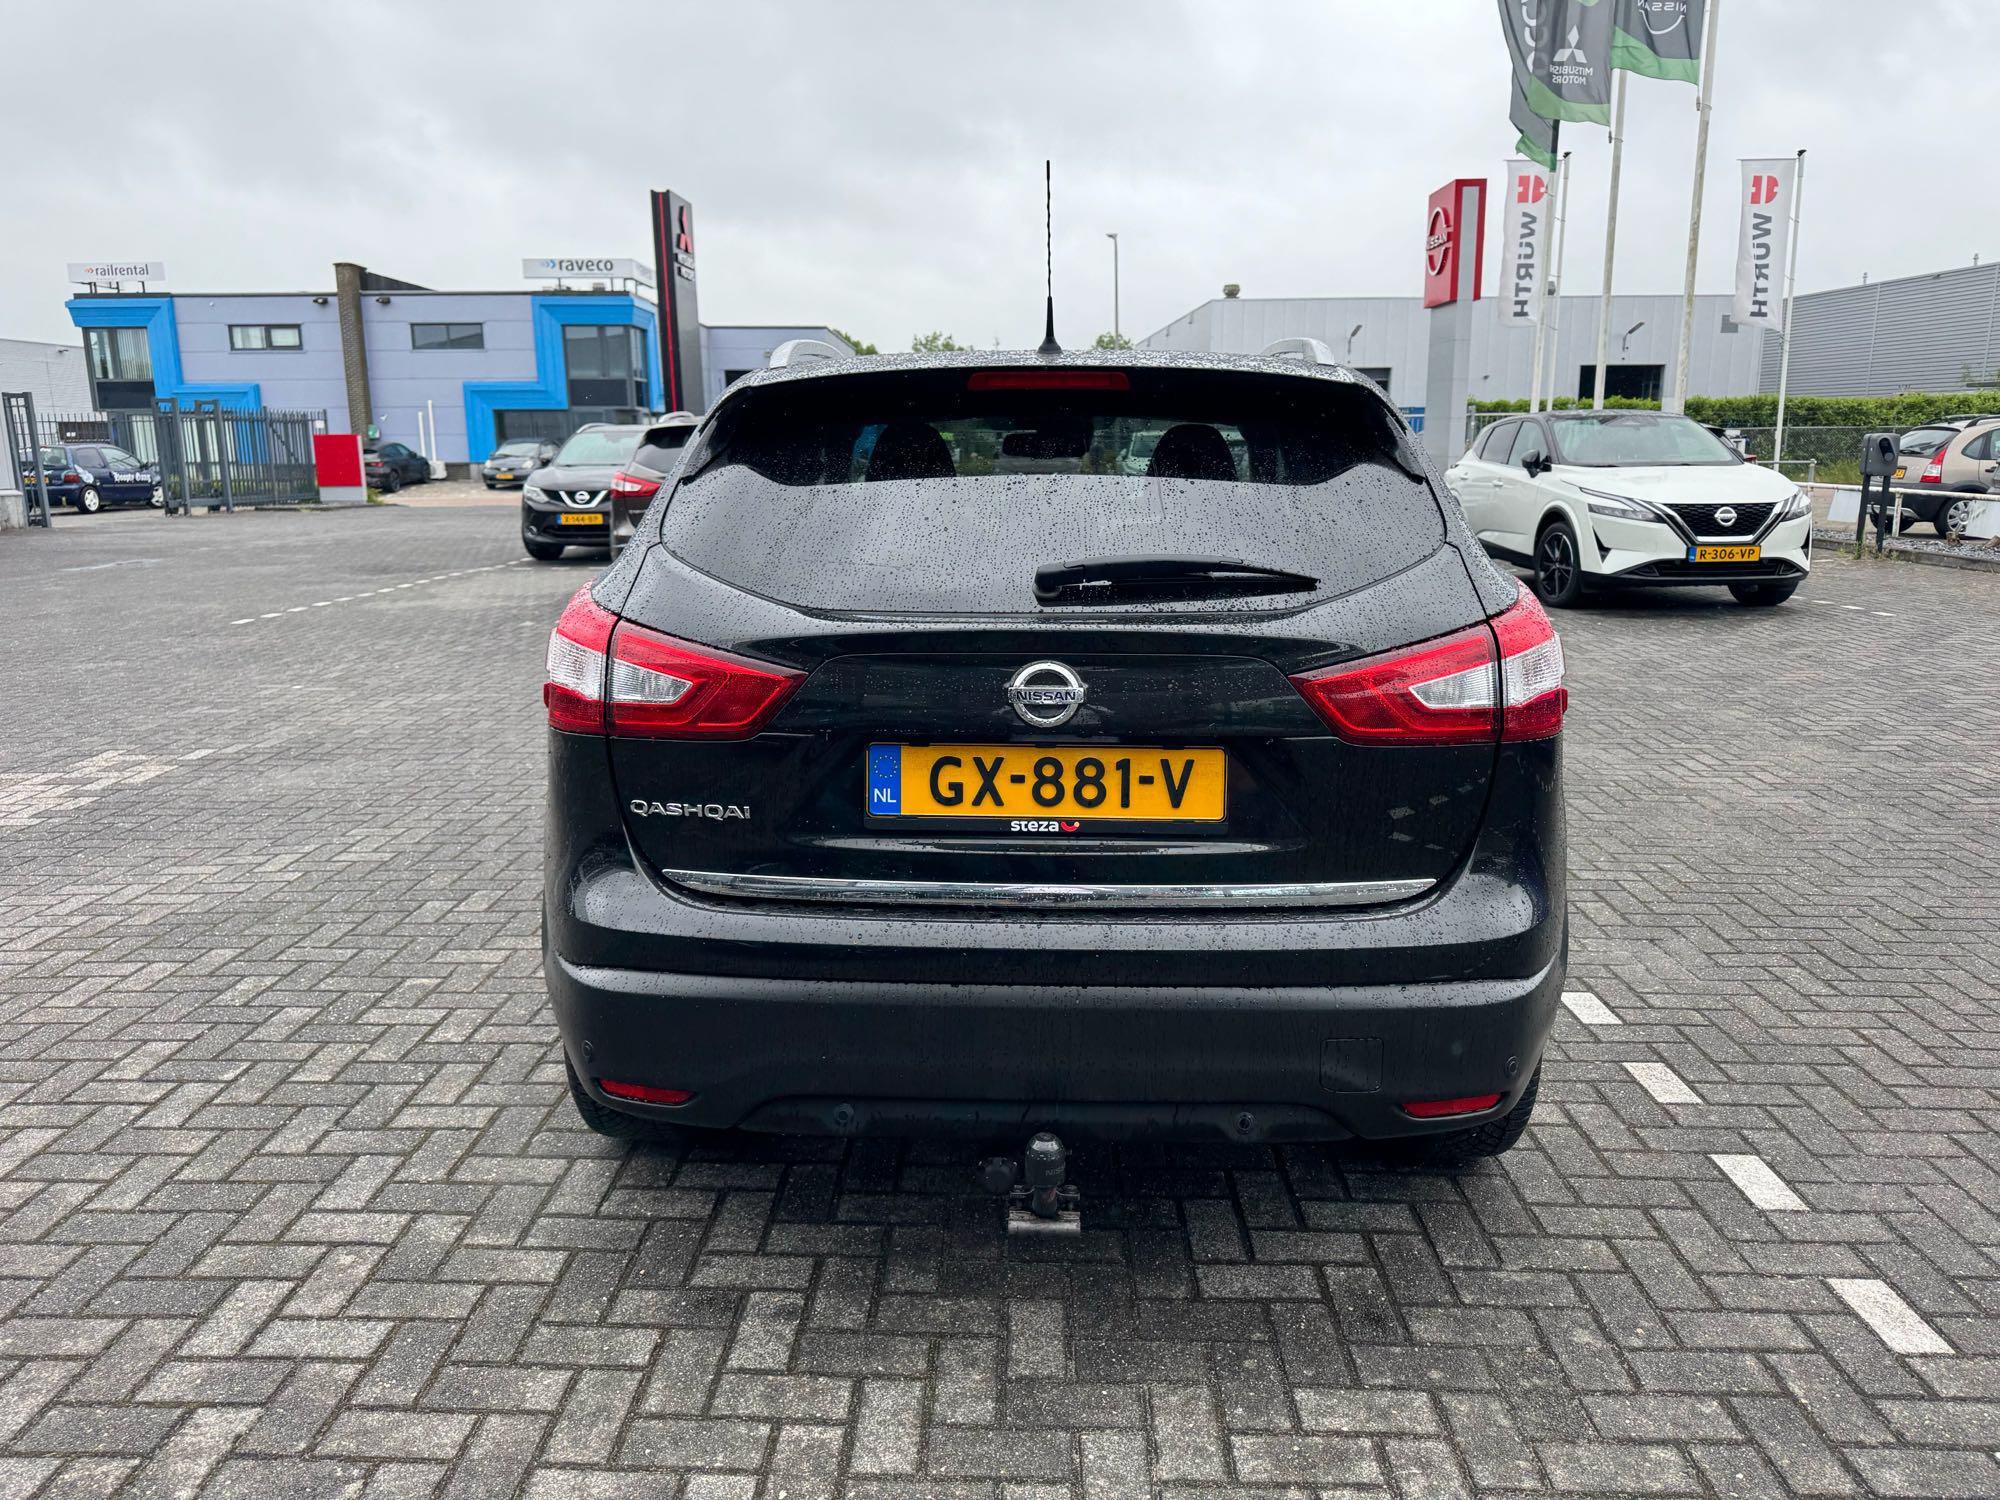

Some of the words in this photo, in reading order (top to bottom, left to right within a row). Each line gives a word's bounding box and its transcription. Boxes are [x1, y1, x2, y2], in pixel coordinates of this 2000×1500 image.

[1427, 232, 1448, 250] SSAN
[95, 264, 149, 276] railrental
[558, 259, 614, 271] raveco
[1699, 548, 1756, 560] R-306-VP
[1016, 691, 1076, 701] NISSAN
[929, 756, 1195, 809] GX-881-V
[873, 788, 897, 803] NL
[630, 799, 751, 820] QASHQAI
[1010, 820, 1060, 832] steza
